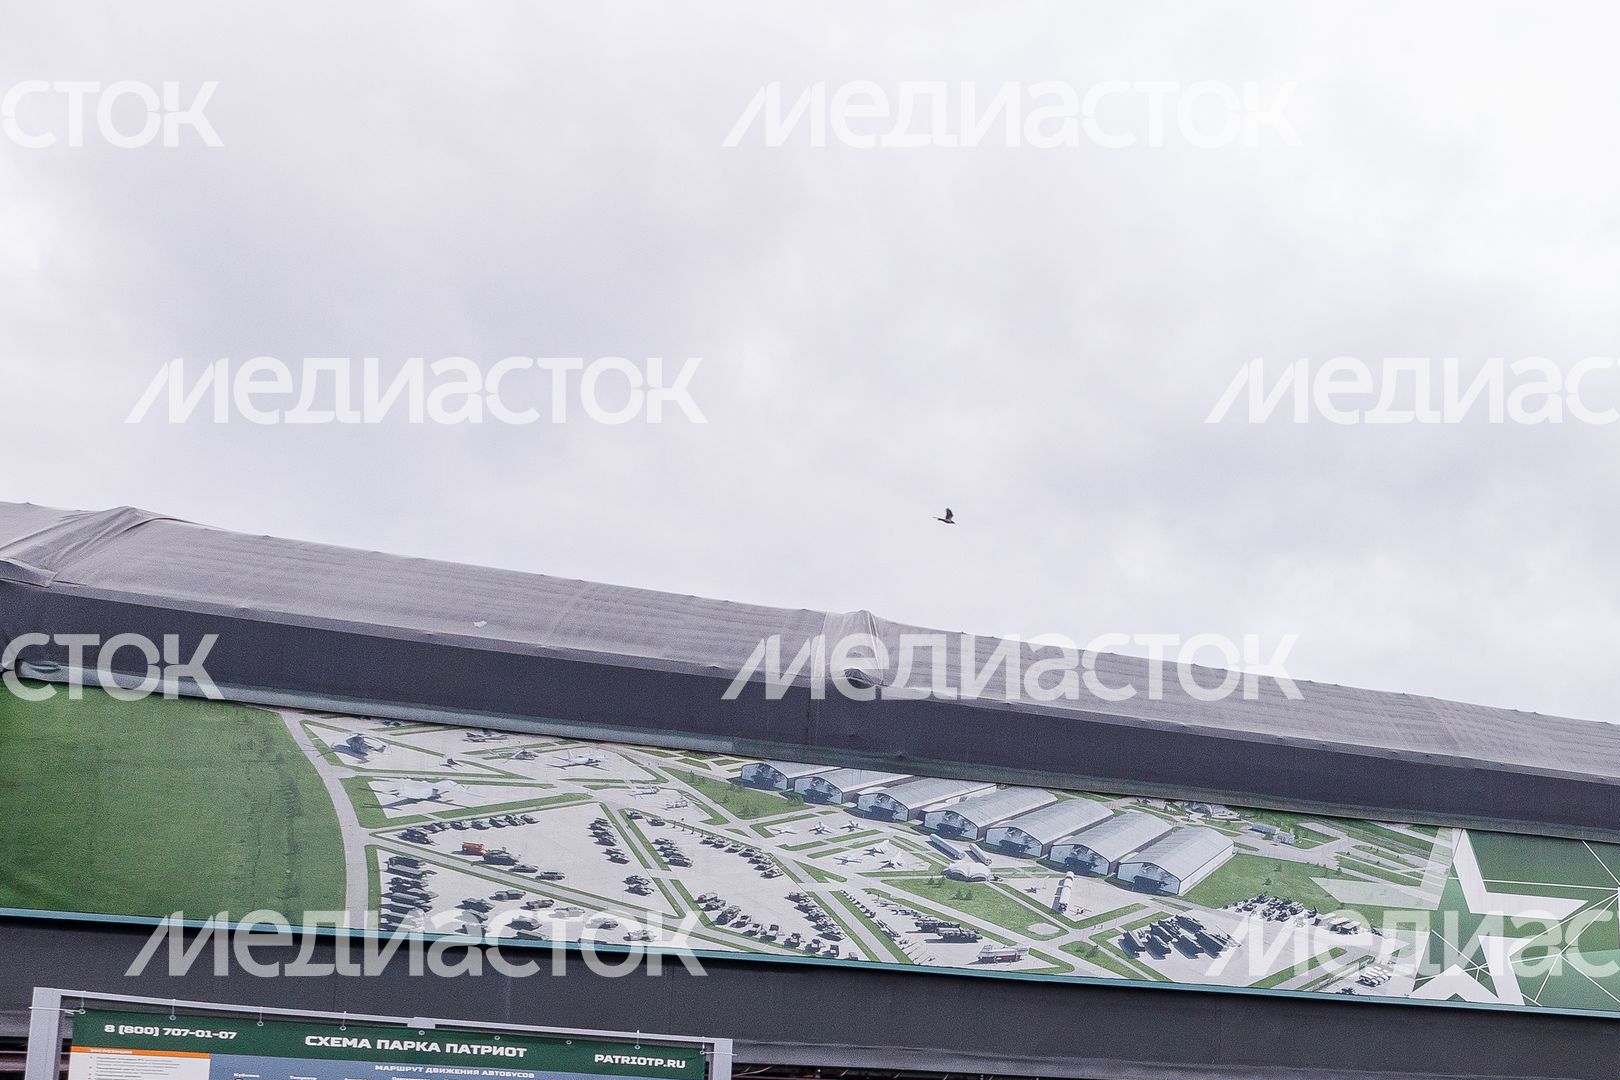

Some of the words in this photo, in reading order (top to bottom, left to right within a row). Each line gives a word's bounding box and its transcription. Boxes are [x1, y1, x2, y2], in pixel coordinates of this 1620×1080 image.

[104, 1024, 115, 1033] 8
[162, 1027, 237, 1040] 707-01-07
[305, 1035, 372, 1048] СХЕМА
[376, 1039, 441, 1053] ПАРКА
[445, 1042, 528, 1058] ПАТРИОТ
[594, 1054, 686, 1069] PATRIOTP.RU
[375, 1065, 424, 1074] МАРШРУТ
[425, 1067, 480, 1076] ДВИЖЕНИЯ
[482, 1070, 535, 1079] АВТОБУСОВ
